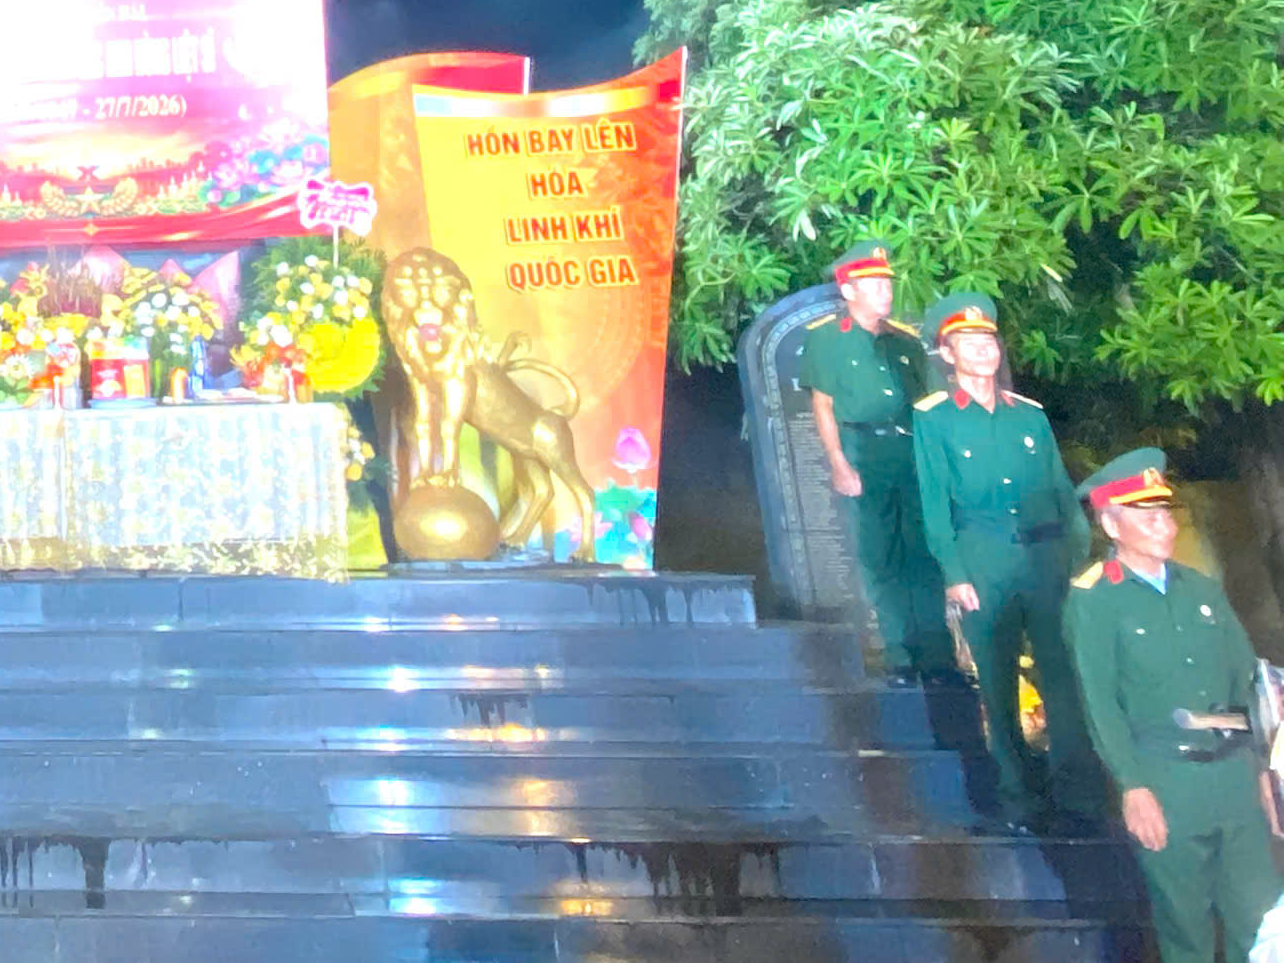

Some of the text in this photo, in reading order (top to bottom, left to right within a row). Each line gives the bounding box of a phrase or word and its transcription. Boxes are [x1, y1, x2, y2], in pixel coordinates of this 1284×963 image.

[528, 128, 575, 154] BAY
[584, 120, 636, 151] LÊN
[507, 216, 568, 243] LINH
[509, 255, 636, 291] QUỐC GIA
